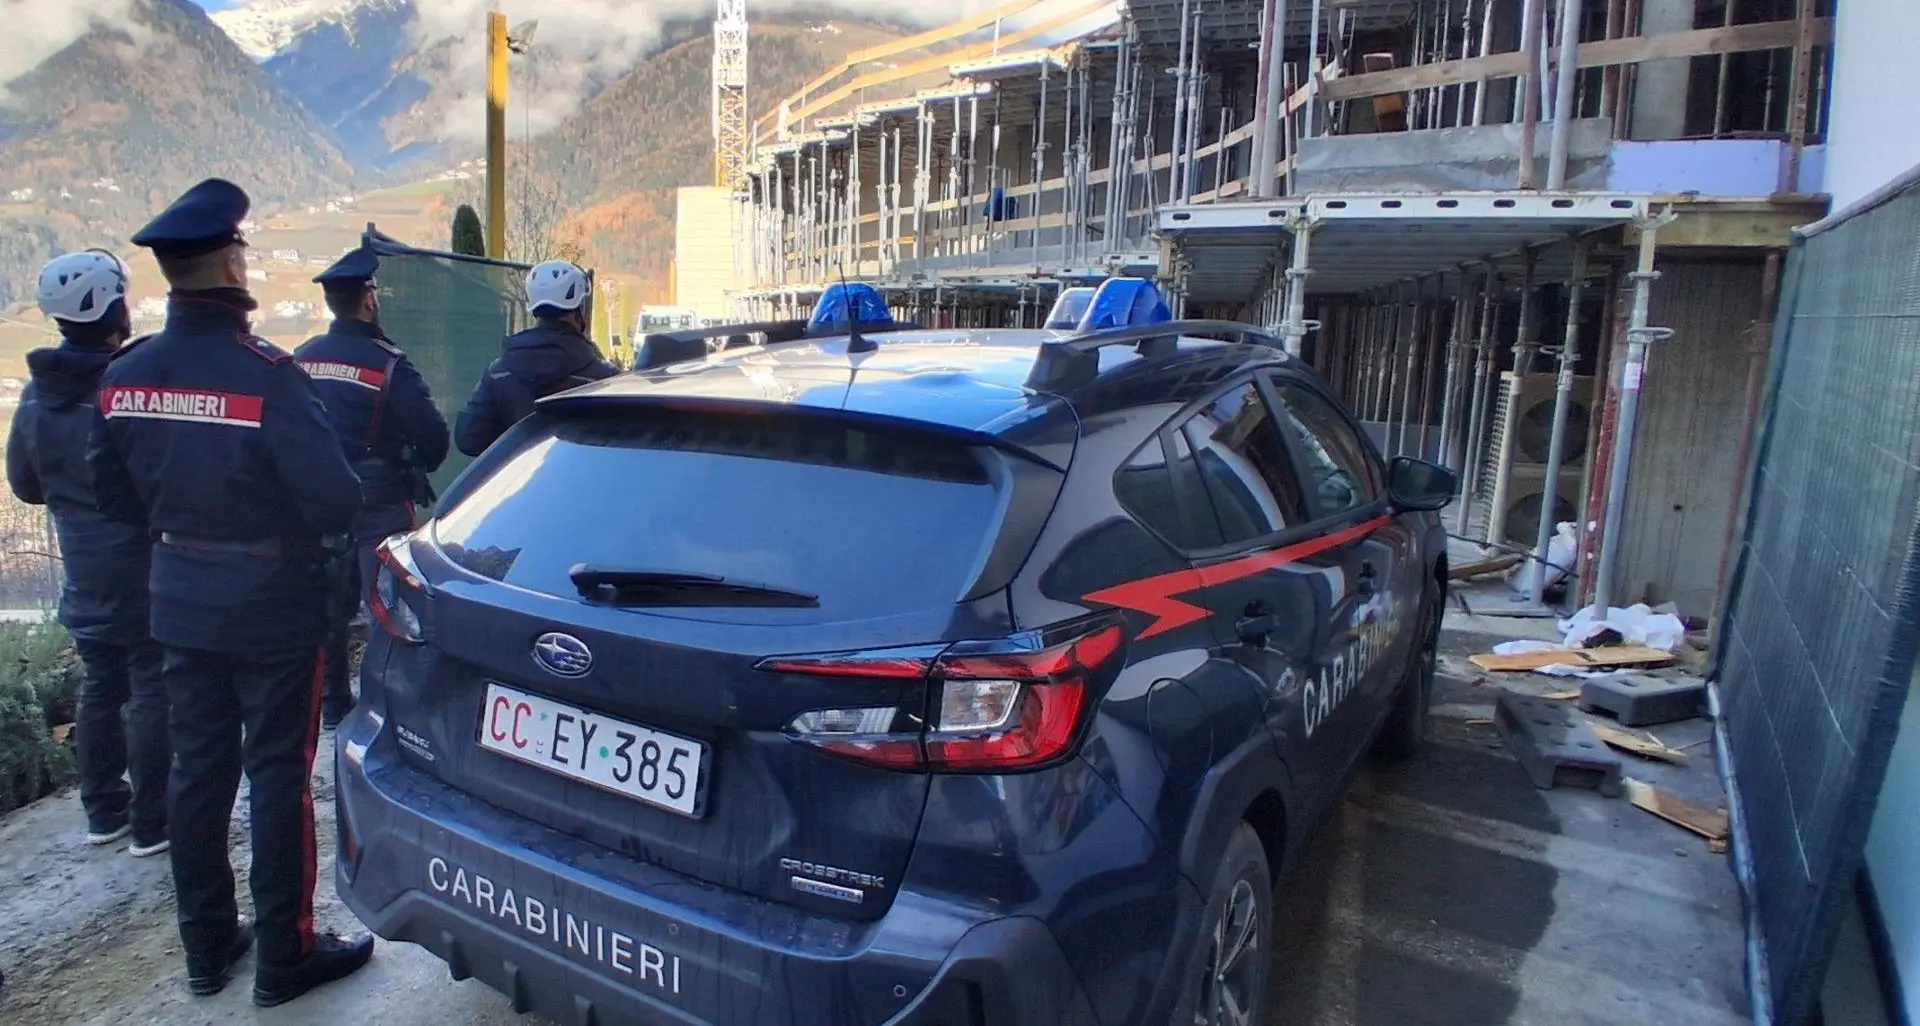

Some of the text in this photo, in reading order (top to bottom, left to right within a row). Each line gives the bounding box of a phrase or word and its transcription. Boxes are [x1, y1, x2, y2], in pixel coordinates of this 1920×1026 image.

[299, 362, 361, 381] RABINIERI
[111, 390, 226, 417] CARABINIERI
[491, 695, 532, 749] CC
[551, 712, 598, 771] EY
[612, 730, 690, 800] 385
[780, 858, 885, 888] CROSSTREK
[428, 856, 682, 994] CARABINIERI
